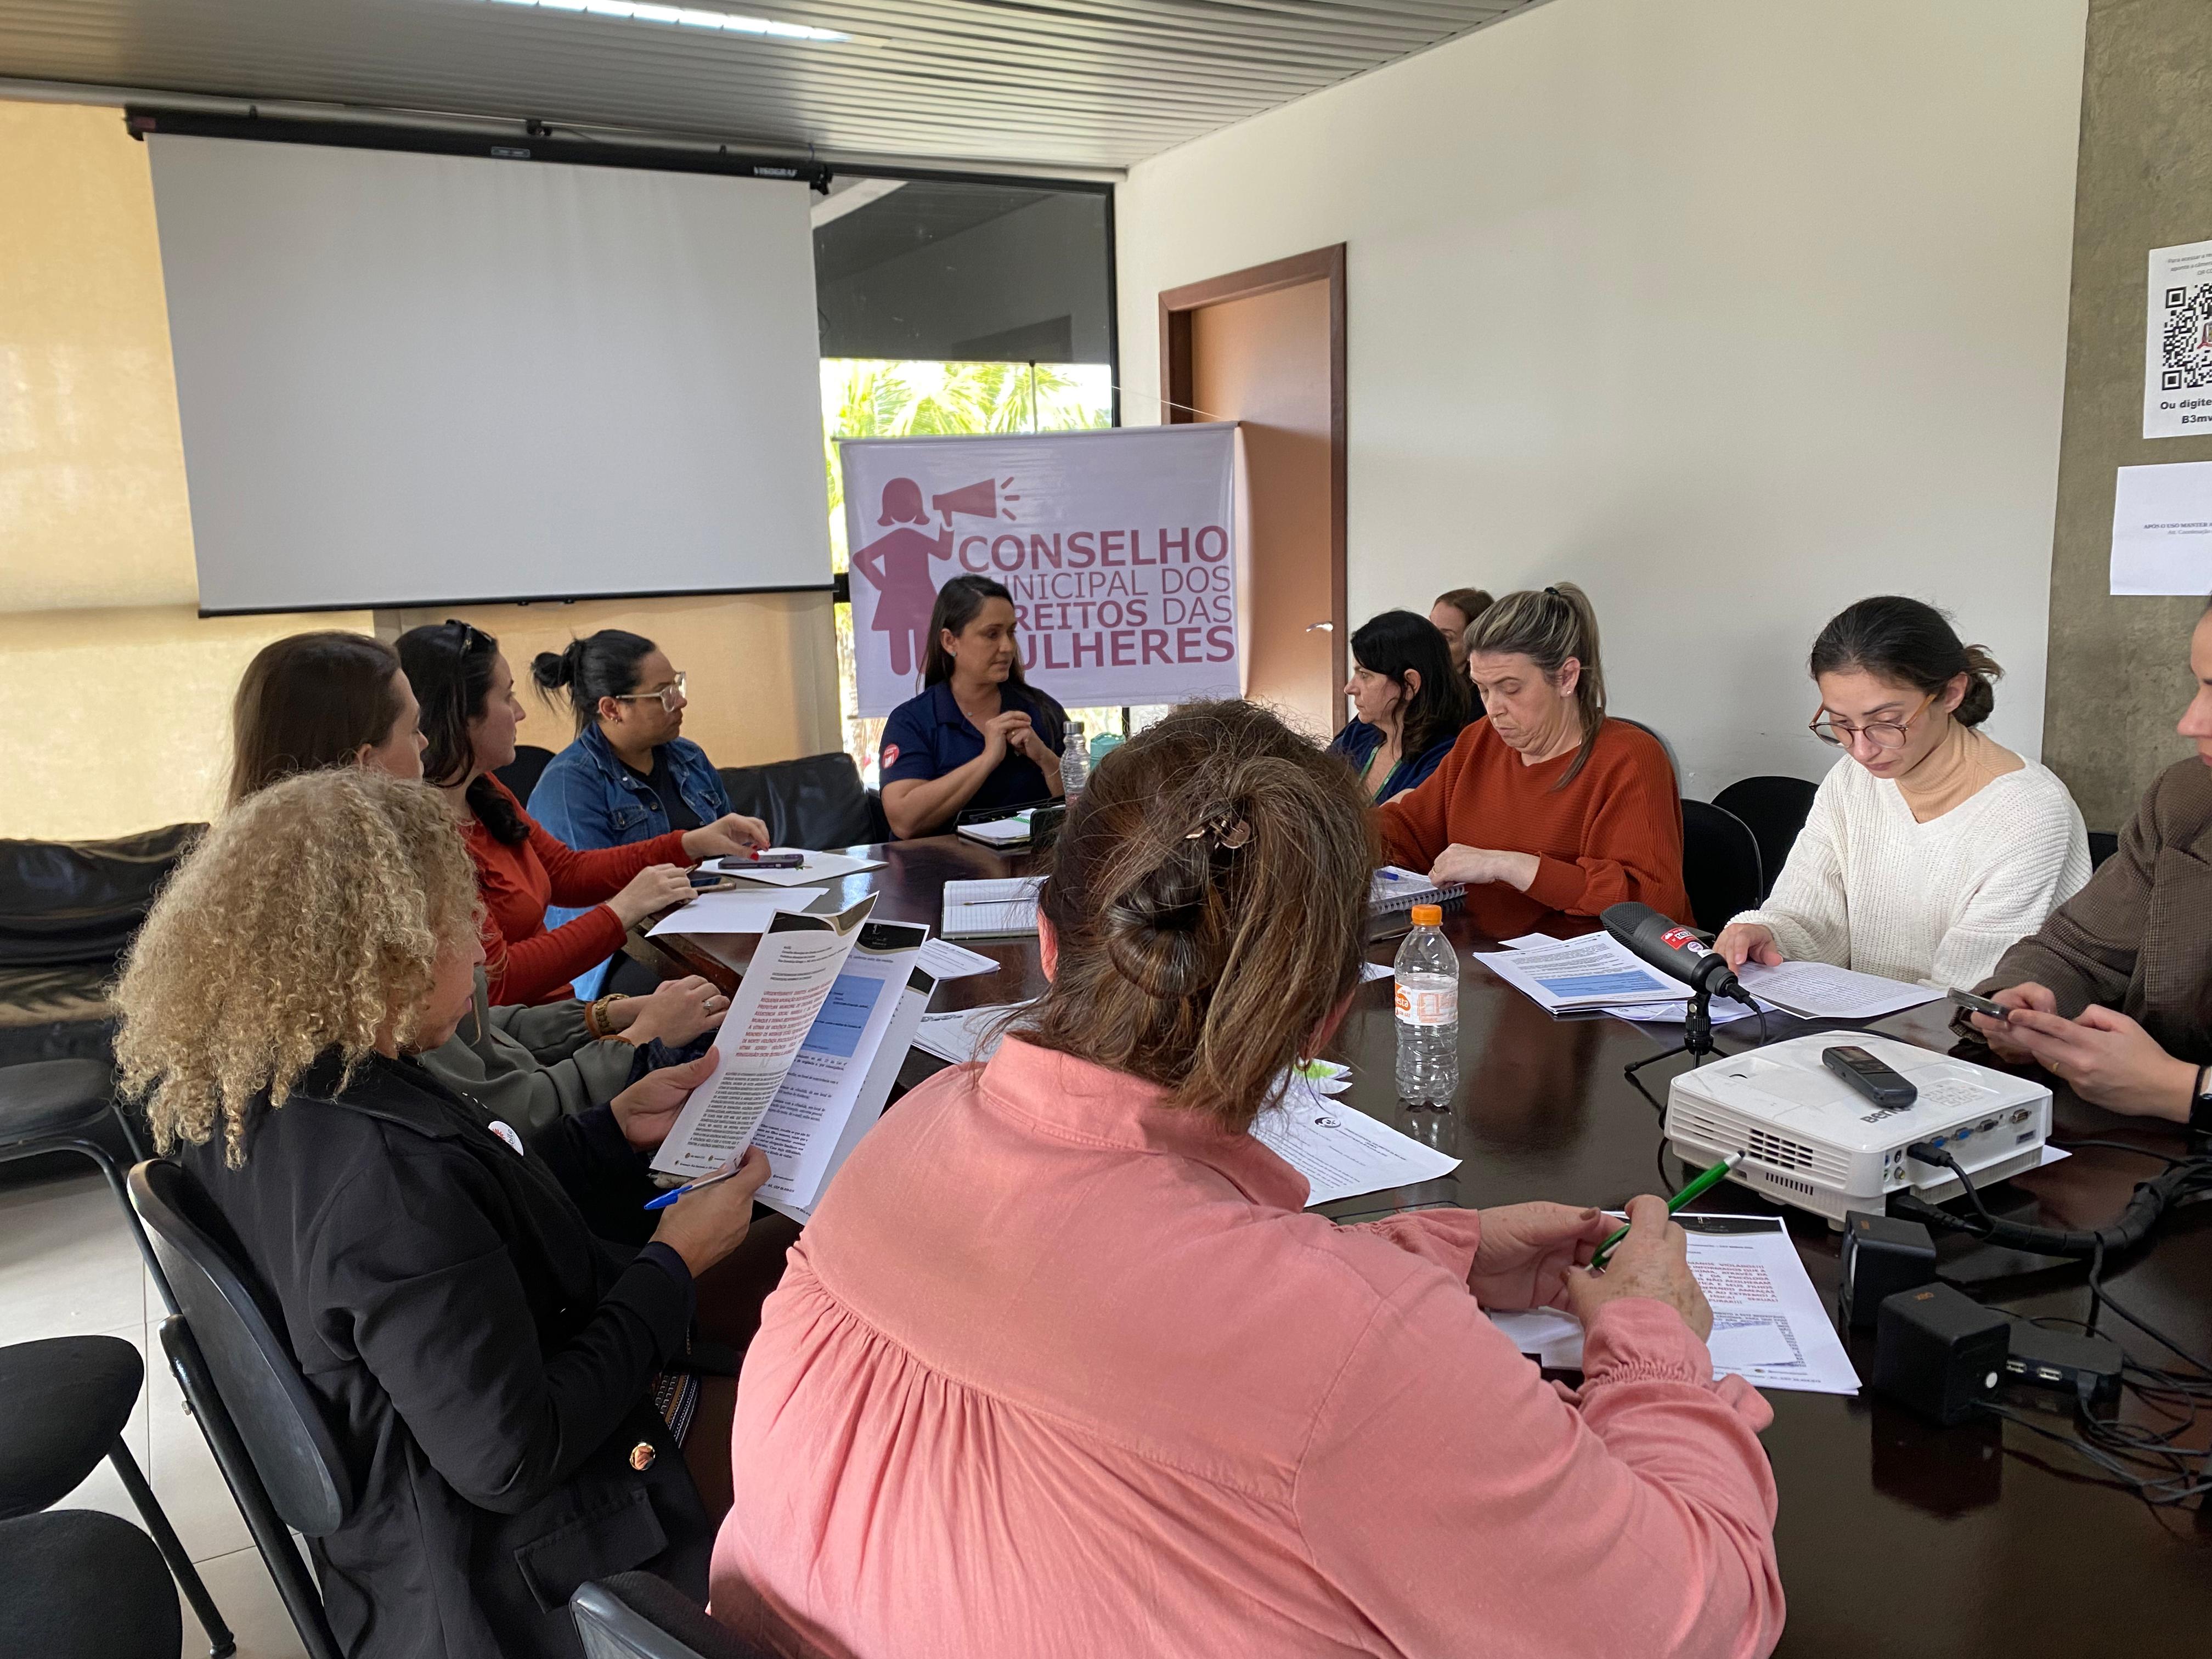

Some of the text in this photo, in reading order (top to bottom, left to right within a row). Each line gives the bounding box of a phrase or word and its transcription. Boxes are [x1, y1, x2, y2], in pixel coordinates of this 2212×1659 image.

[2160, 398, 2212, 410] Ou digite
[960, 526, 1228, 572] CONSELHO
[1004, 566, 1231, 601] NICIPAL DOS
[1015, 595, 1233, 631] REITOS DAS
[1024, 625, 1235, 670] ULHERES
[1860, 1108, 1911, 1124] Ben
